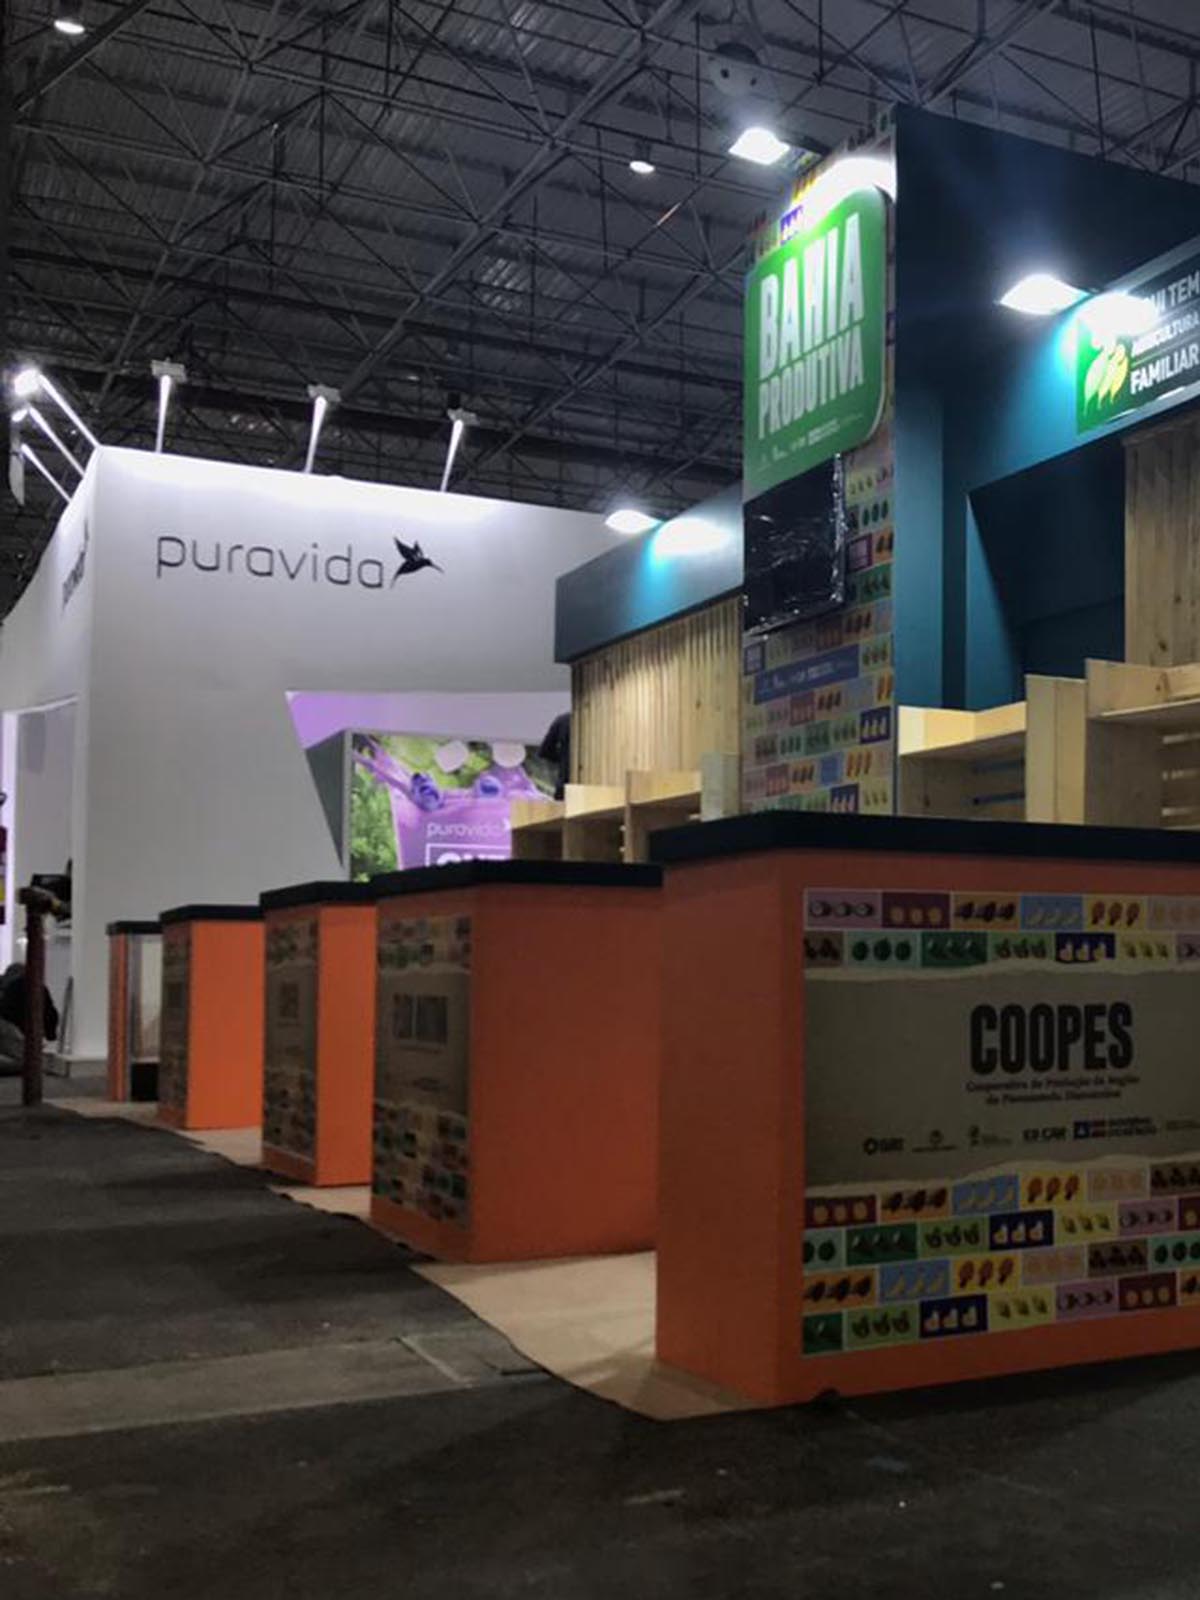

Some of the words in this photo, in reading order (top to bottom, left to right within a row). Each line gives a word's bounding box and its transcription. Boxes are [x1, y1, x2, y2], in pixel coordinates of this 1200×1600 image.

[759, 211, 866, 382] BAHIA
[1168, 270, 1200, 308] TEM
[758, 324, 865, 441] PRODUTIVA
[1130, 343, 1200, 395] FAMILIAR
[156, 535, 385, 589] puravida
[970, 1002, 1134, 1076] COOPES
